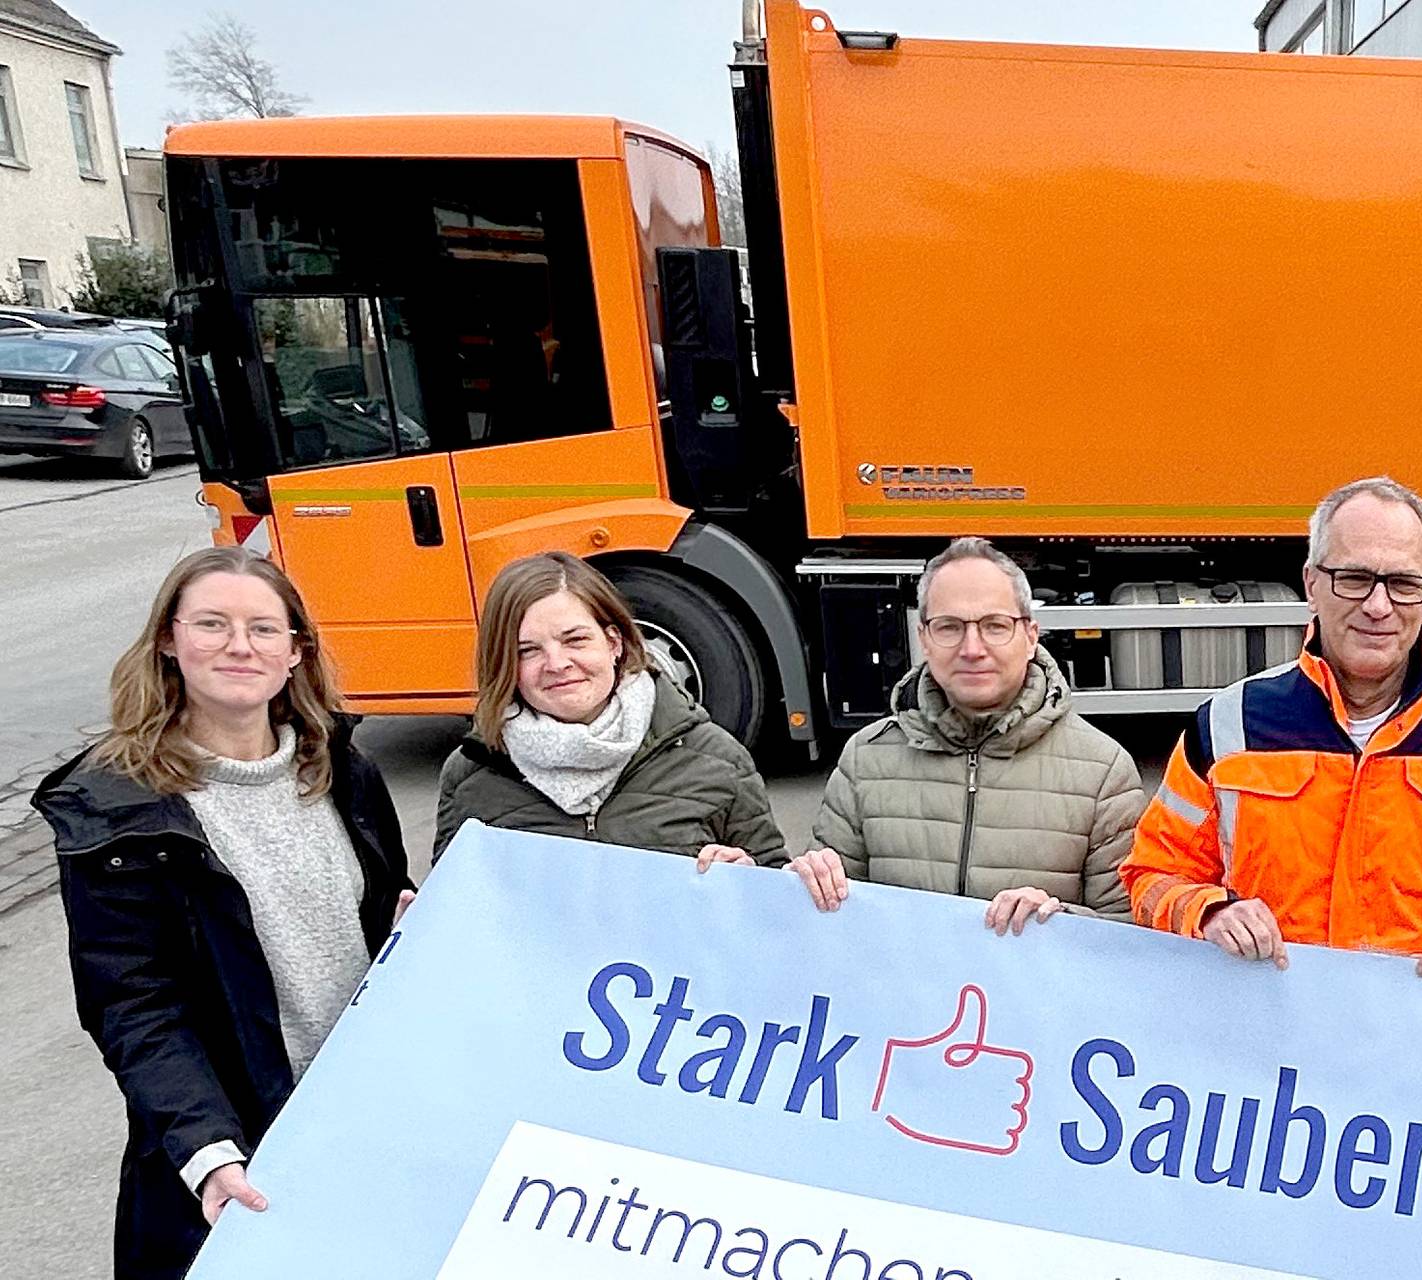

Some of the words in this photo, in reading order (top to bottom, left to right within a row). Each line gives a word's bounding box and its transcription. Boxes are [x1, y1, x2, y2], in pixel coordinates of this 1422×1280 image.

[880, 465, 974, 484] FAUN
[882, 487, 1026, 500] VARIOPRESS
[562, 962, 859, 1121] Stark
[503, 1175, 973, 1280] mitmach
